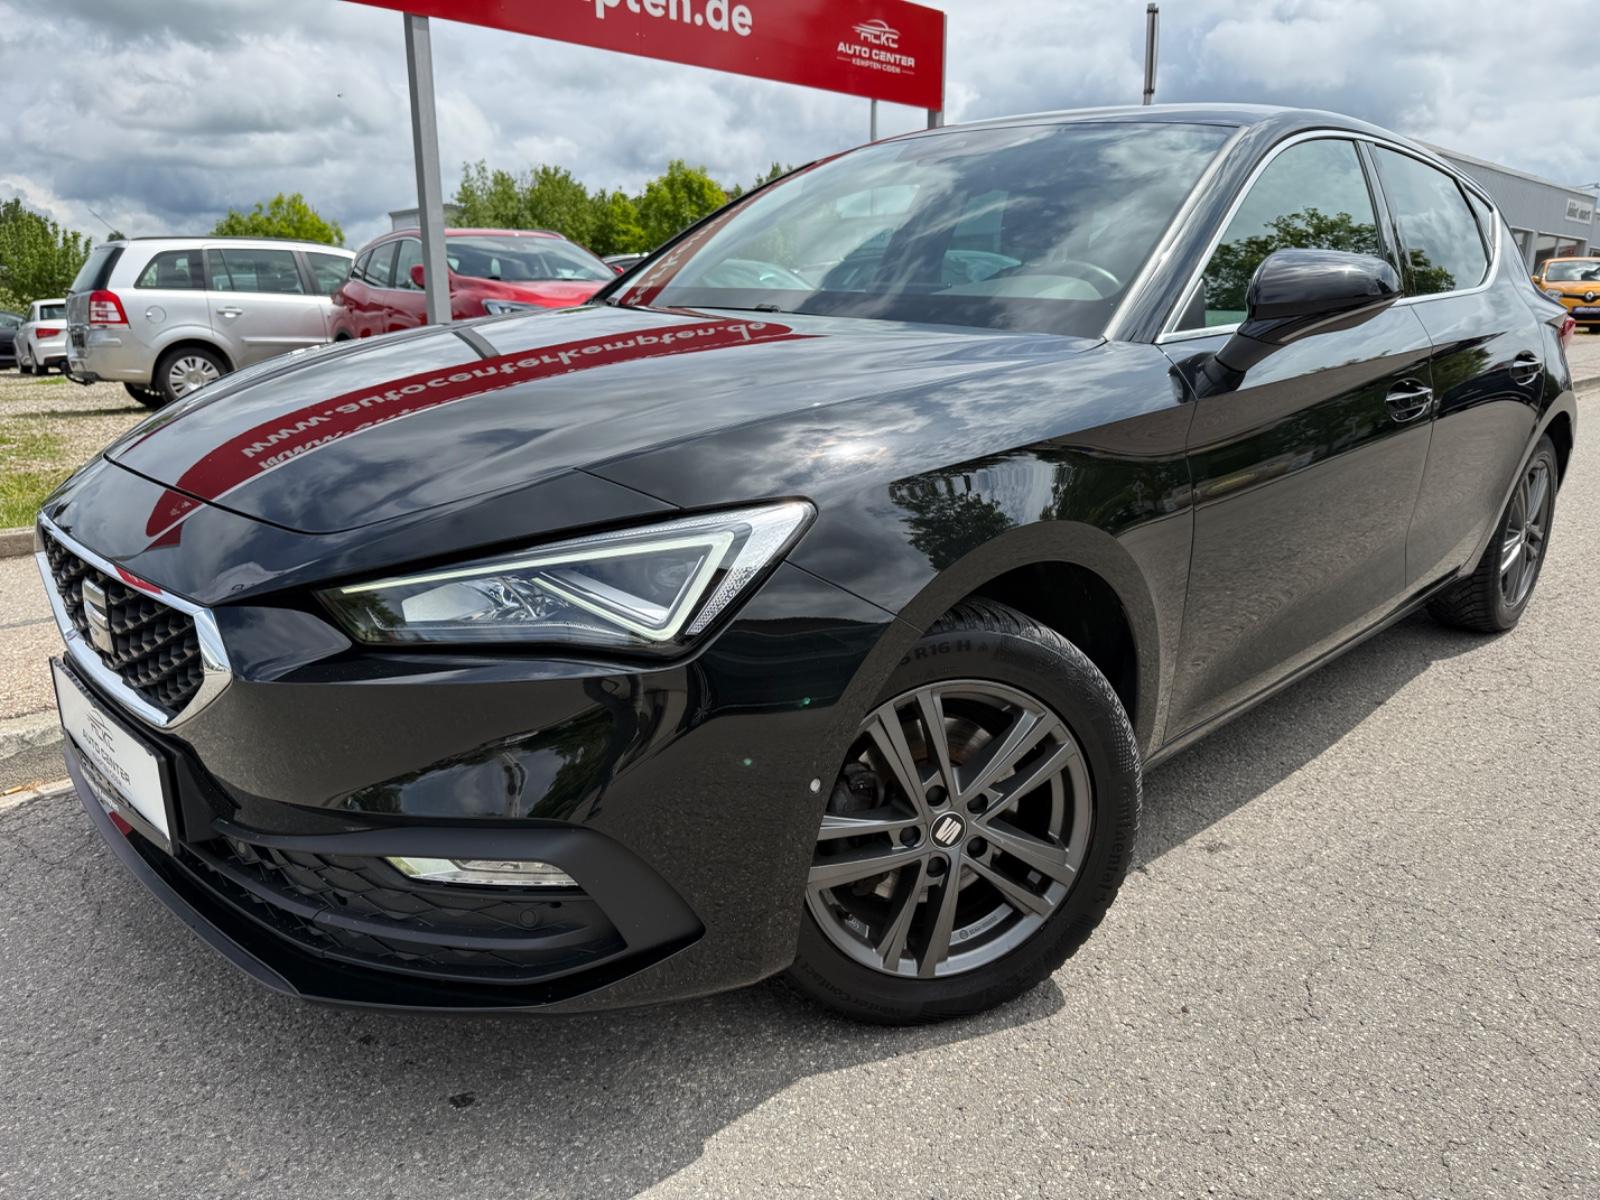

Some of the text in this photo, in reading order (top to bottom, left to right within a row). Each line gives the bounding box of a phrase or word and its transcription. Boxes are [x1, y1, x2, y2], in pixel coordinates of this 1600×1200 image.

[837, 41, 916, 68] AUTO CENTER
[101, 747, 132, 786] CENTER
